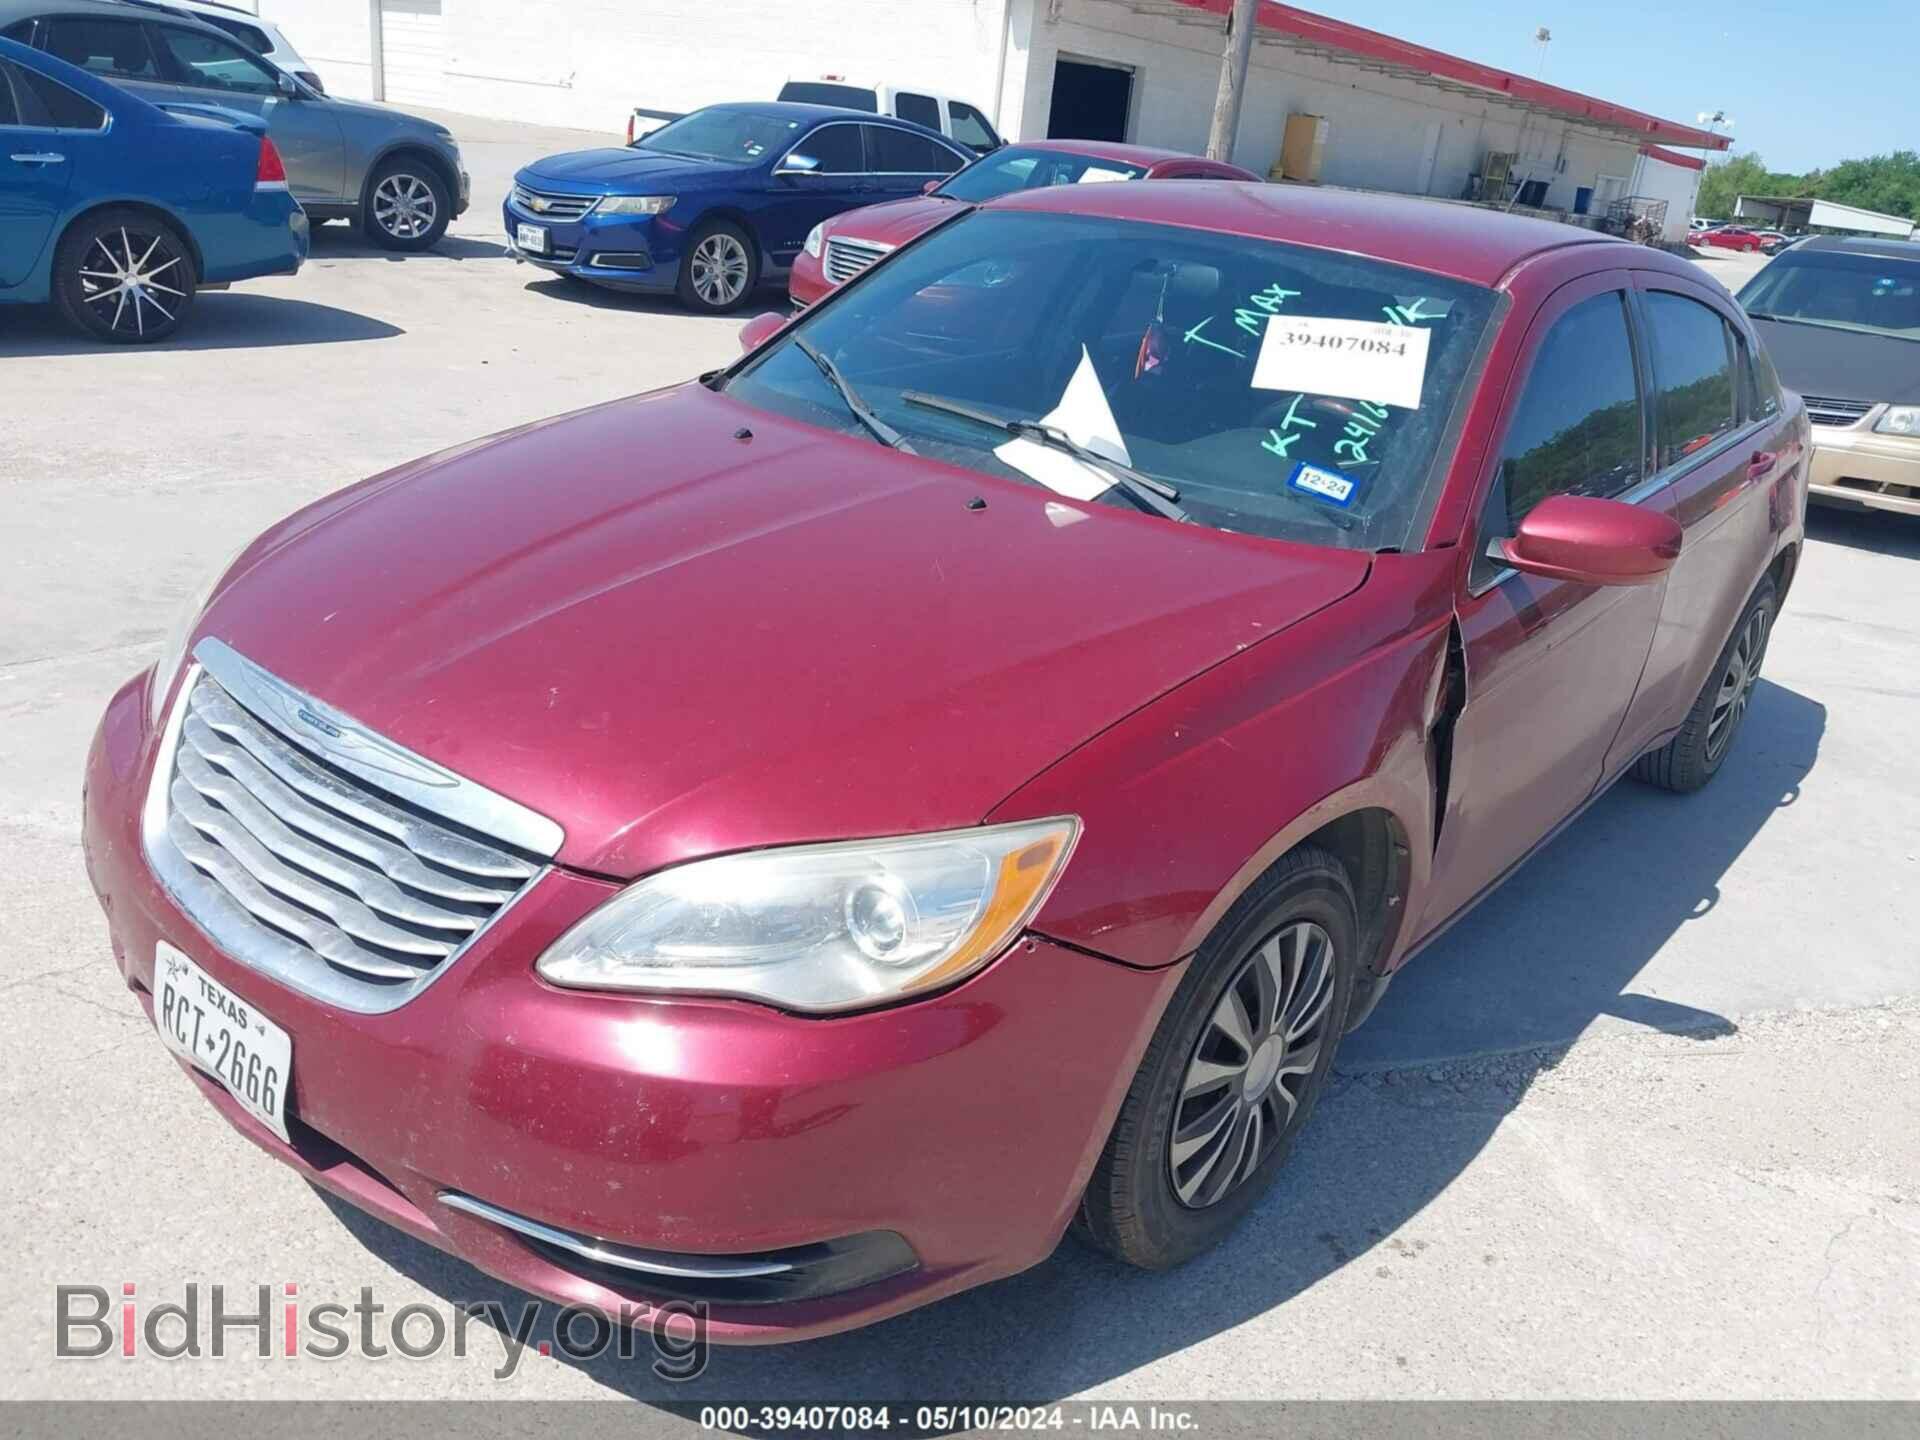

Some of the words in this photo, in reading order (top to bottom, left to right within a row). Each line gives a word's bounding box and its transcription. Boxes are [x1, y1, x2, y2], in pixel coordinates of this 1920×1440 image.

[1184, 316, 1248, 359] T
[1234, 283, 1302, 337] MAX
[1280, 332, 1407, 356] 39407084
[198, 976, 248, 1029] TEXAS
